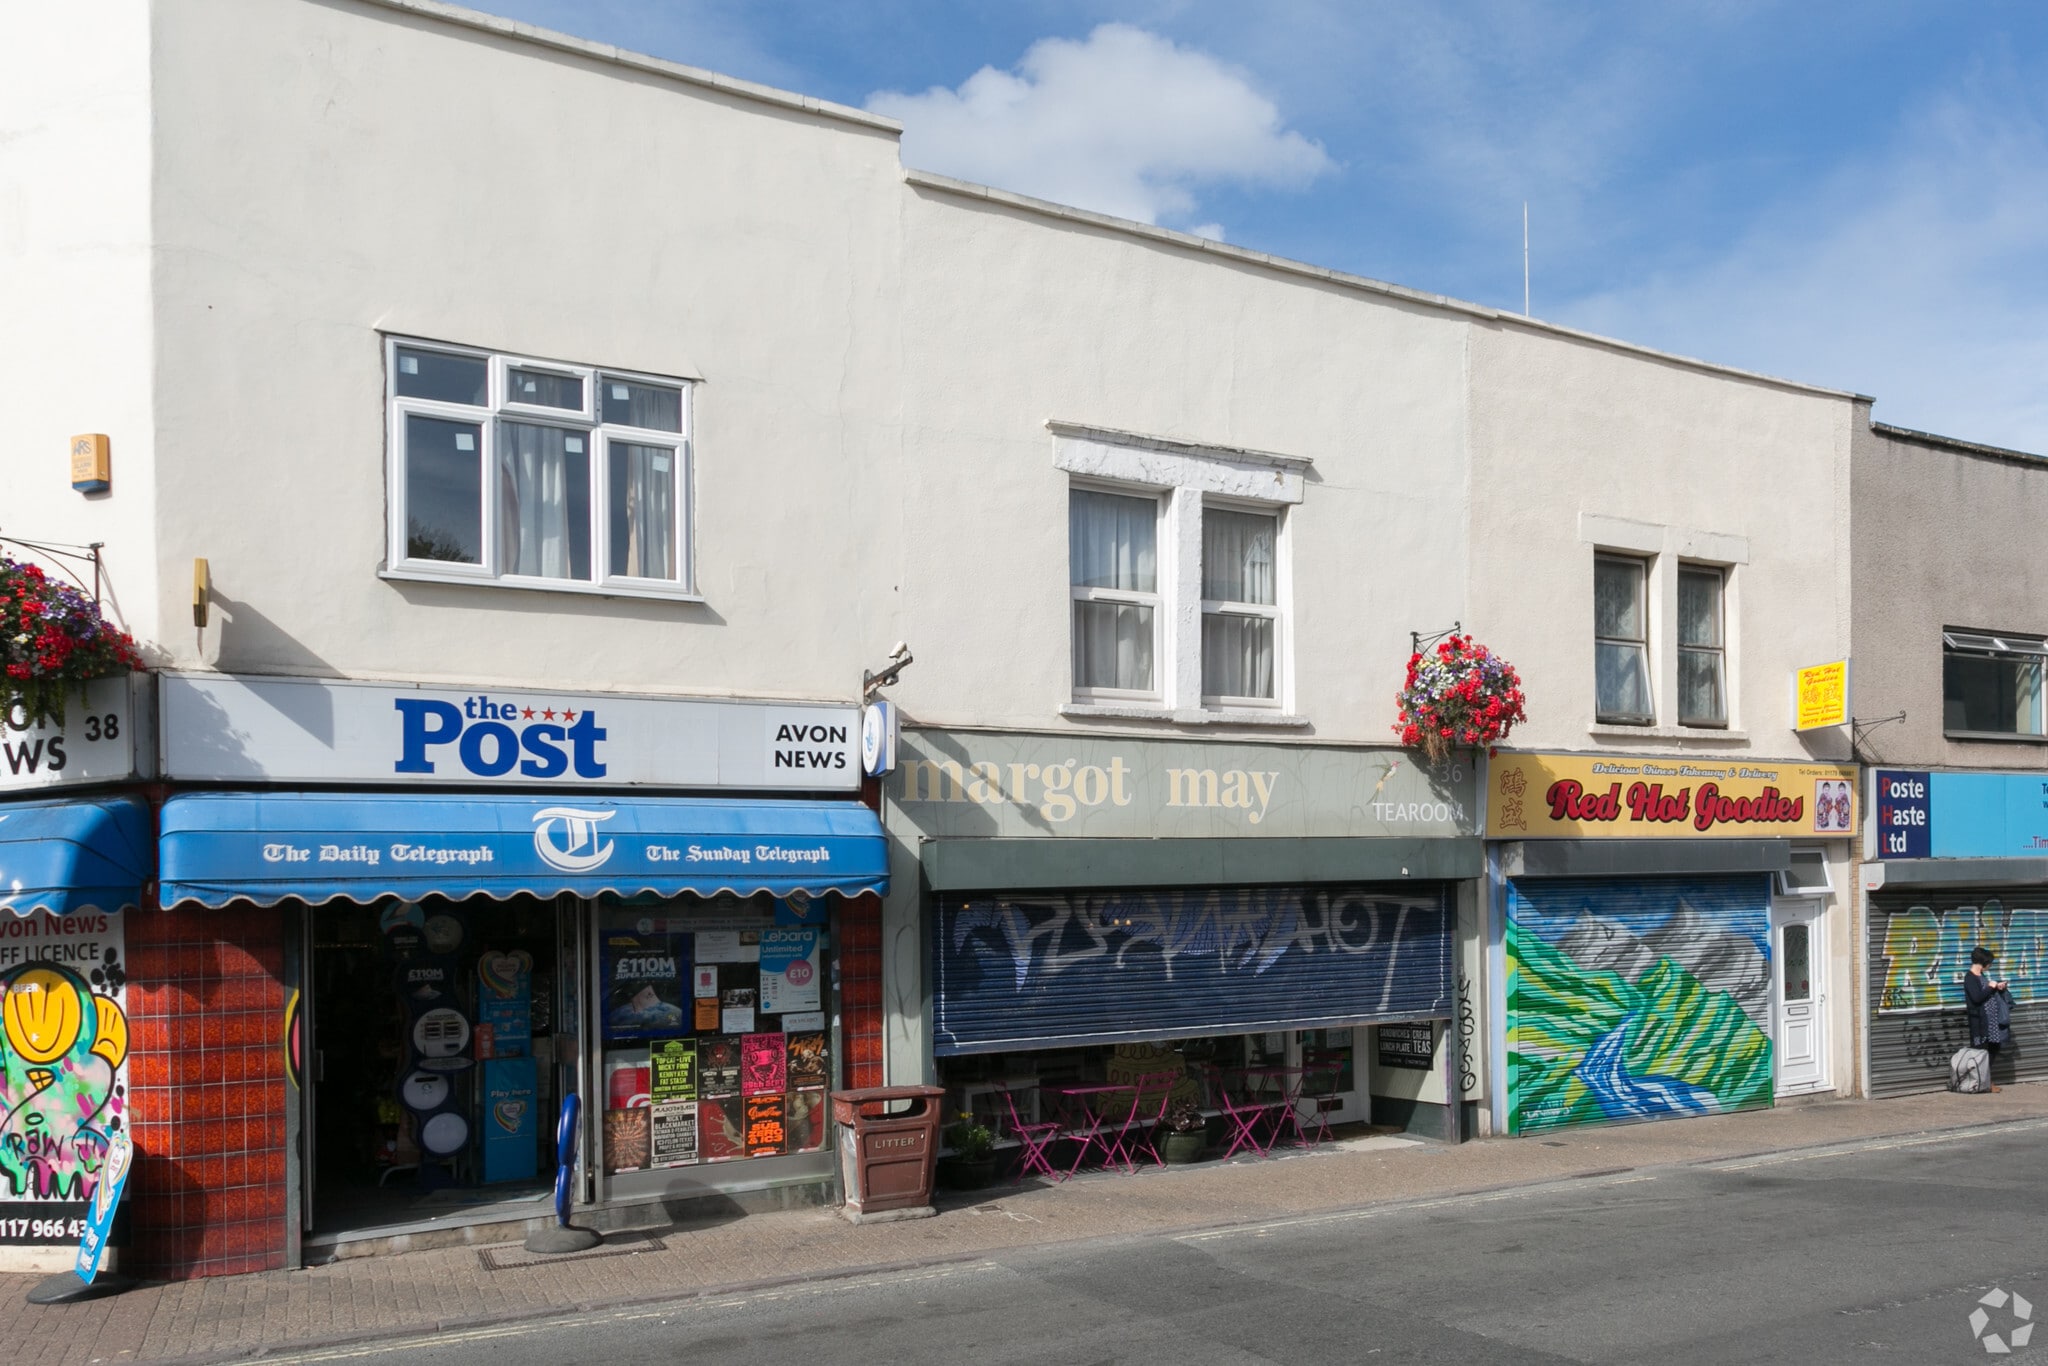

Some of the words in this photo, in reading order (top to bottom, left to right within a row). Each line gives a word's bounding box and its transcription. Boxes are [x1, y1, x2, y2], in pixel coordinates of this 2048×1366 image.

[463, 696, 517, 721] the
[85, 714, 119, 742] 38
[775, 724, 847, 744] AVON
[394, 698, 607, 779] Post
[775, 750, 846, 769] NEWS
[1441, 764, 1462, 783] 36
[1593, 763, 1640, 775] Delicious
[1642, 764, 1678, 775] Chinese
[1680, 765, 1726, 779] Takeaway
[1728, 767, 1736, 777] &
[1739, 767, 1779, 780] Delivery
[899, 757, 1132, 822] margot
[1166, 767, 1280, 824] may
[1881, 777, 1925, 799] Poste
[1372, 803, 1463, 822] TEAROOM
[1546, 779, 1622, 822] Red
[1627, 782, 1691, 823] Hot
[1693, 783, 1804, 831] Goodies
[1882, 805, 1926, 826] Haste
[1882, 831, 1907, 853] Ltd
[263, 843, 310, 862] The
[319, 844, 380, 865] Daily
[390, 843, 494, 865] Telegraph
[646, 845, 681, 862] The
[685, 845, 751, 864] Sunday
[755, 845, 830, 863] Telegraph
[45, 913, 108, 936] News
[761, 930, 813, 943] Lebara
[26, 943, 99, 962] LICENCE
[762, 945, 803, 953] Unlimited
[616, 957, 677, 973] £110M
[790, 968, 809, 978] £10
[615, 972, 640, 980] SUPER
[641, 970, 677, 979] JACKPOT
[1379, 1027, 1410, 1039] SANDWICHES
[1412, 1029, 1431, 1040] CREAM
[1379, 1041, 1395, 1051] LUNCH
[1396, 1042, 1411, 1053] PLATE
[1412, 1040, 1432, 1054] TEAS
[490, 1089, 511, 1099] Play
[655, 1120, 696, 1129] BLACKMARKET
[748, 1128, 784, 1138] ZERO
[751, 1121, 780, 1131] SUB
[748, 1137, 758, 1145] &
[875, 1137, 915, 1149] LITTER
[32, 1219, 66, 1238] 966
